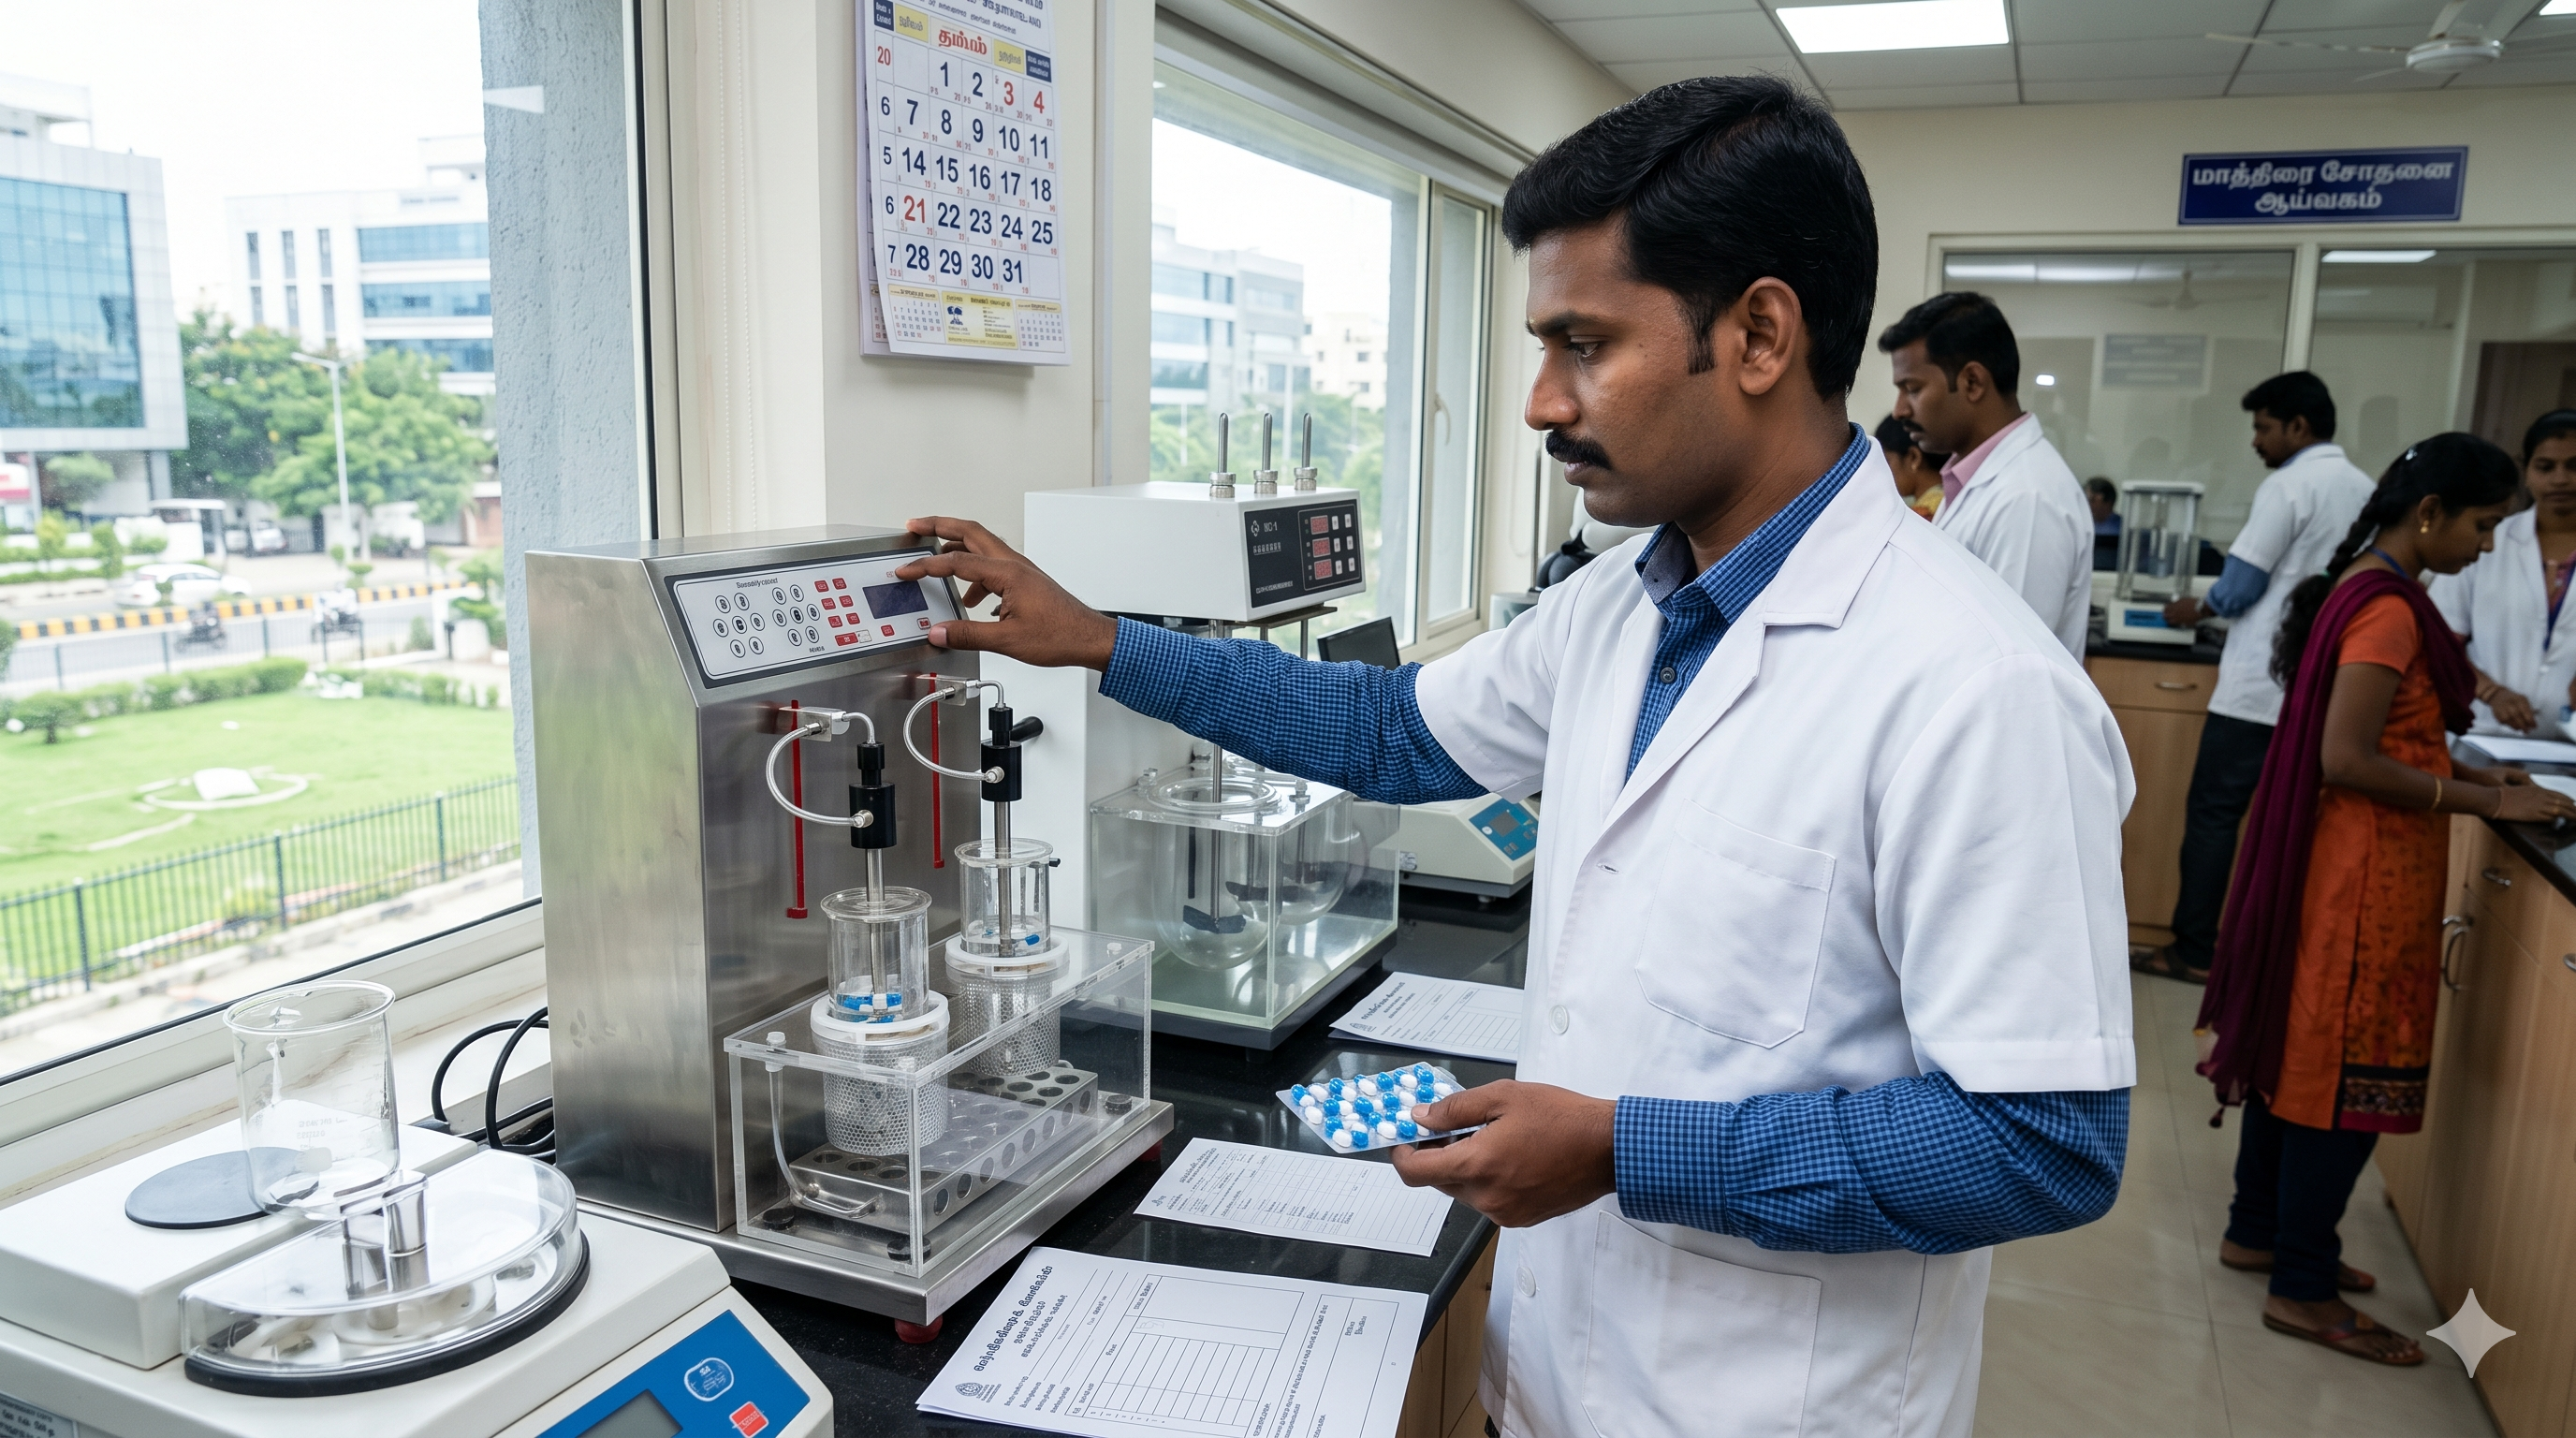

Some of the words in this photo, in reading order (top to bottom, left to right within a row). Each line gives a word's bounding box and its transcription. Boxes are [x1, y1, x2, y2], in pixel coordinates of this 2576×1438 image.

[877, 46, 891, 66] 20
[940, 61, 949, 87] 1
[972, 71, 984, 97] 2
[1003, 81, 1015, 106] 3
[1033, 90, 1046, 114] 4
[881, 95, 891, 116] 6
[906, 98, 919, 125] 7
[941, 109, 953, 135] 8
[972, 118, 984, 143] 9
[998, 125, 1020, 153] 10
[1029, 133, 1048, 160] 11
[883, 145, 892, 166] 5
[901, 146, 927, 176] 14
[935, 154, 959, 183] 15
[968, 163, 991, 190] 16
[1000, 169, 1021, 196] 17
[1030, 176, 1052, 202] 18
[2192, 161, 2316, 190] மாத்திரை
[2320, 159, 2454, 187] சோதனை
[886, 195, 895, 215] 6
[903, 194, 926, 224] 21
[937, 201, 961, 230] 22
[969, 208, 992, 235] 23
[1001, 213, 1024, 241] 24
[1032, 219, 1054, 245] 25
[2254, 187, 2383, 216] ஆய்வகம்
[887, 244, 897, 264] 7
[905, 243, 930, 271] 28
[939, 248, 962, 276] 29
[971, 253, 994, 280] 30
[1003, 257, 1023, 285] 31
